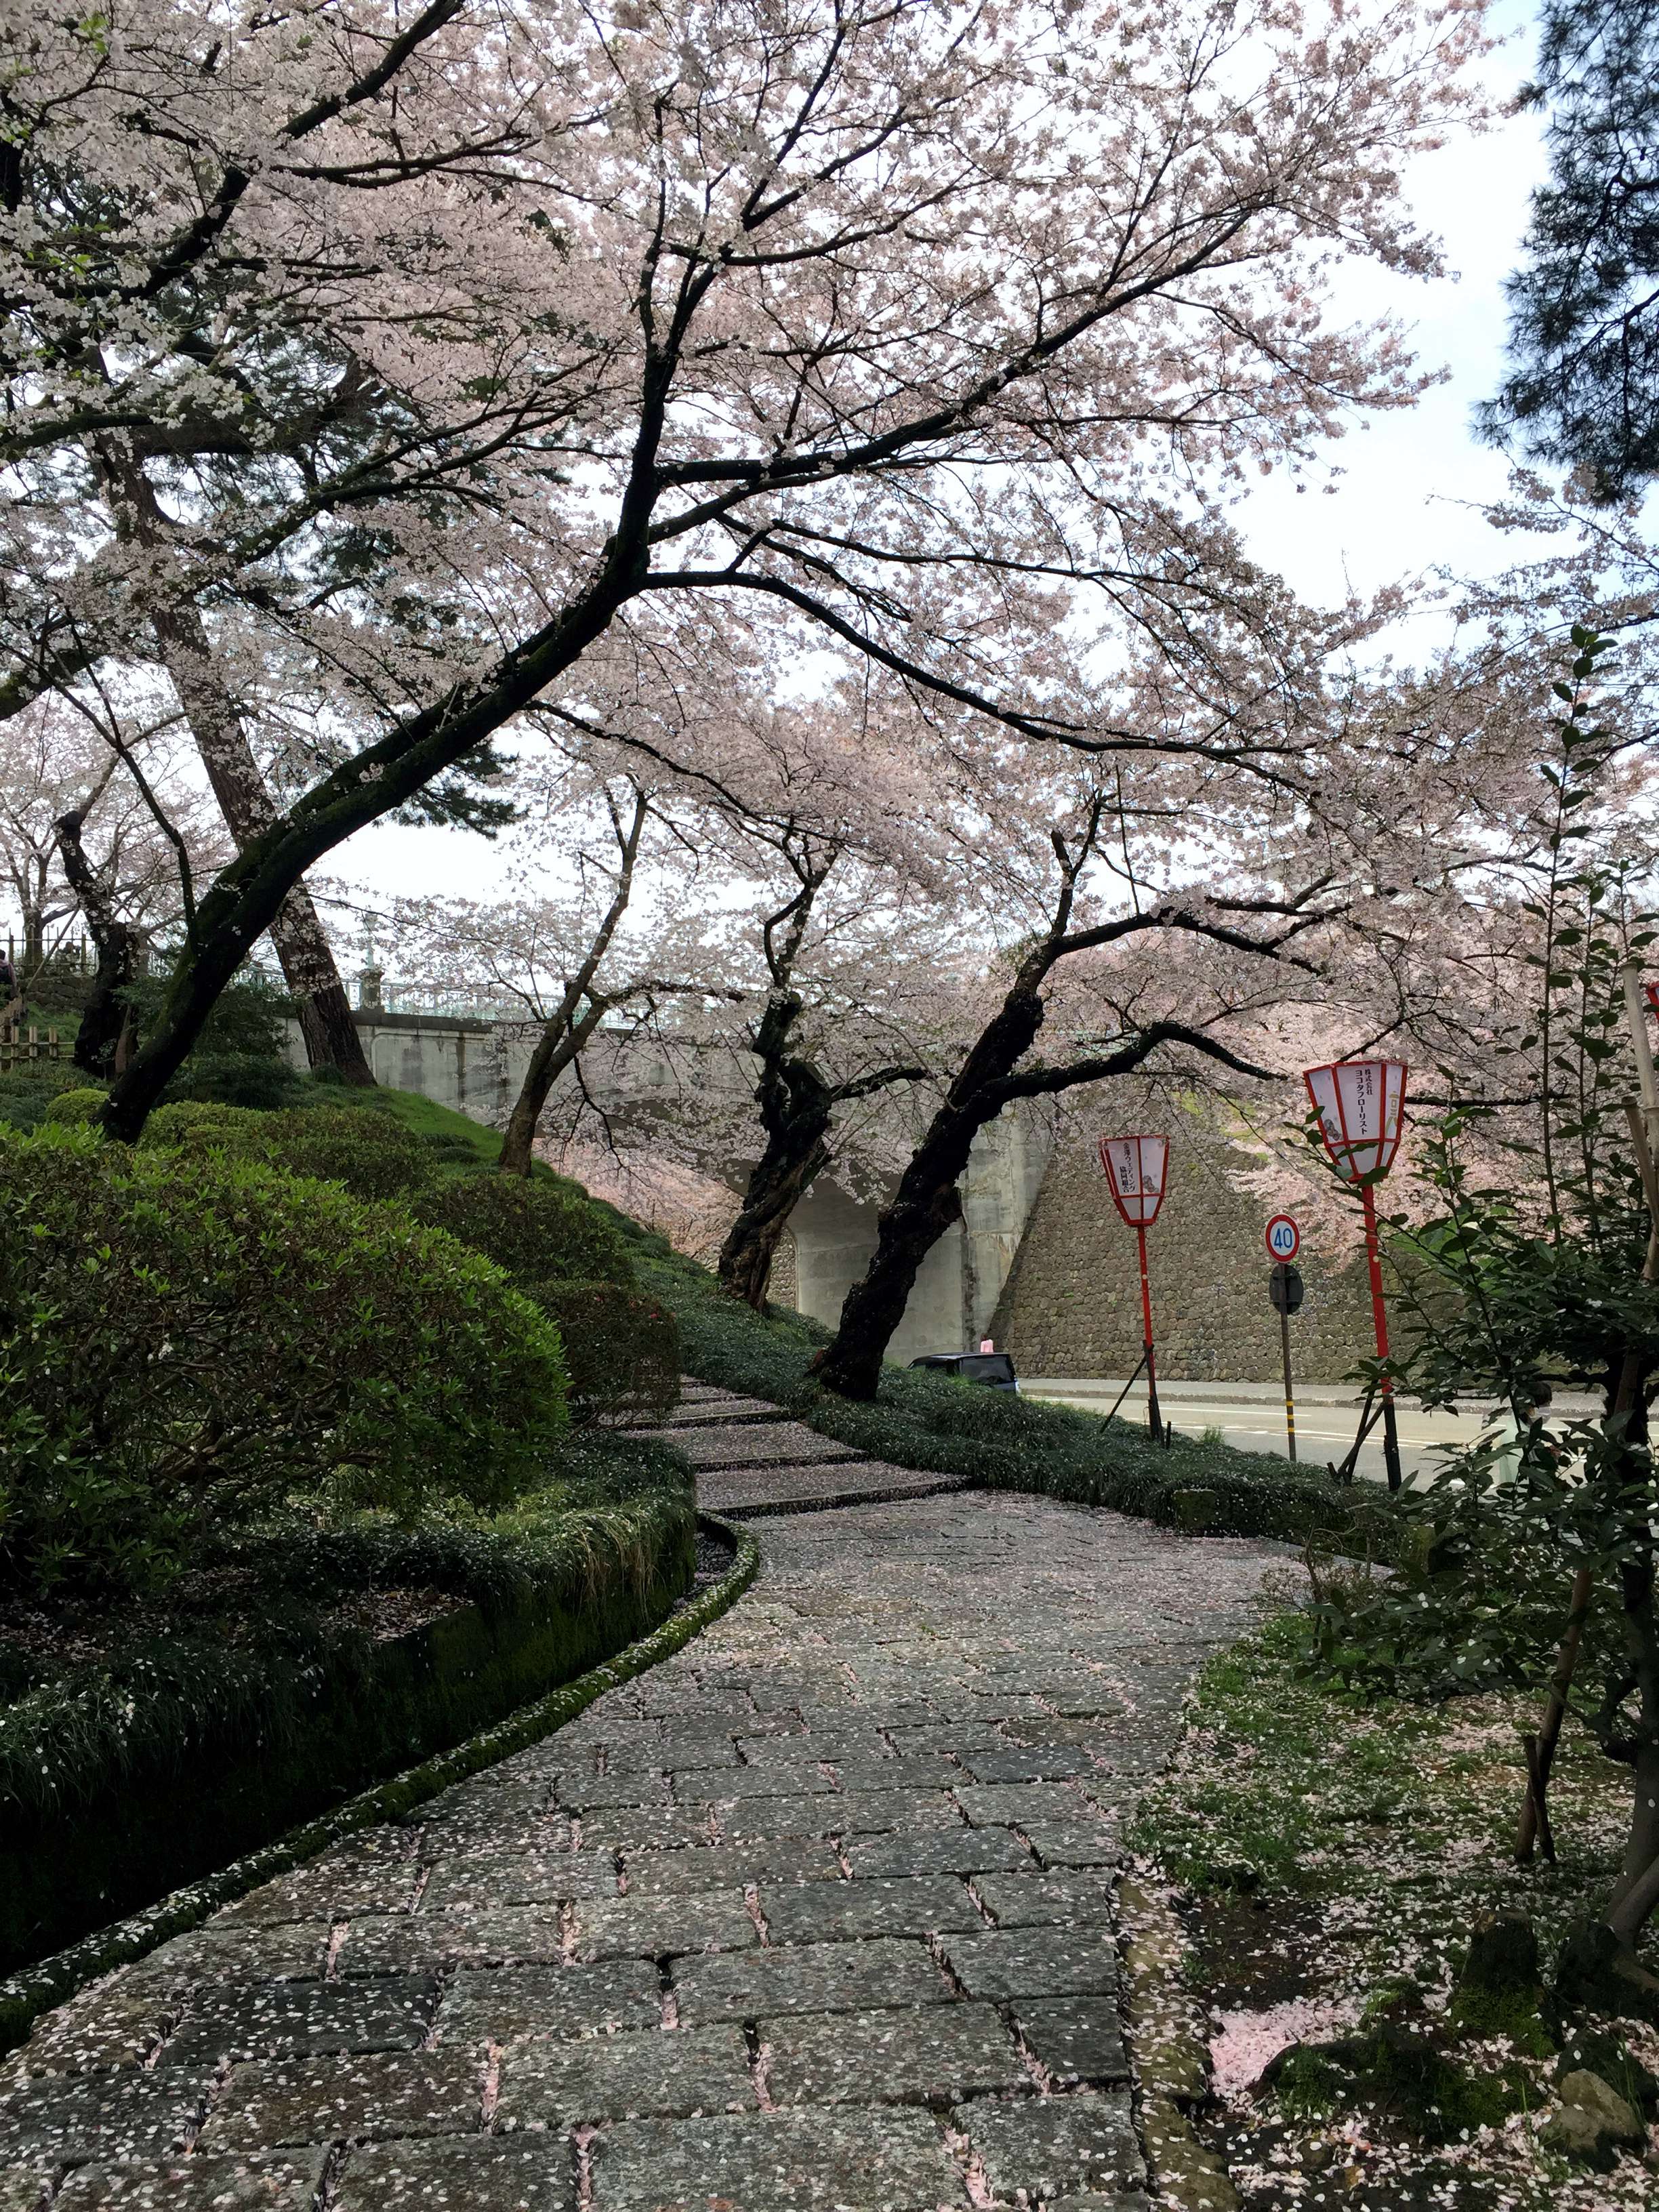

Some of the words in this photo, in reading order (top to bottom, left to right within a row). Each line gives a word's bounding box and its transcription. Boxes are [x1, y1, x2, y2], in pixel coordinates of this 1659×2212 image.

[1364, 1068, 1372, 1095] 株式会社
[1355, 1069, 1368, 1135] ヨコタフローリスト
[1119, 1166, 1129, 1193] 協同組合
[1274, 1227, 1292, 1248] 40
